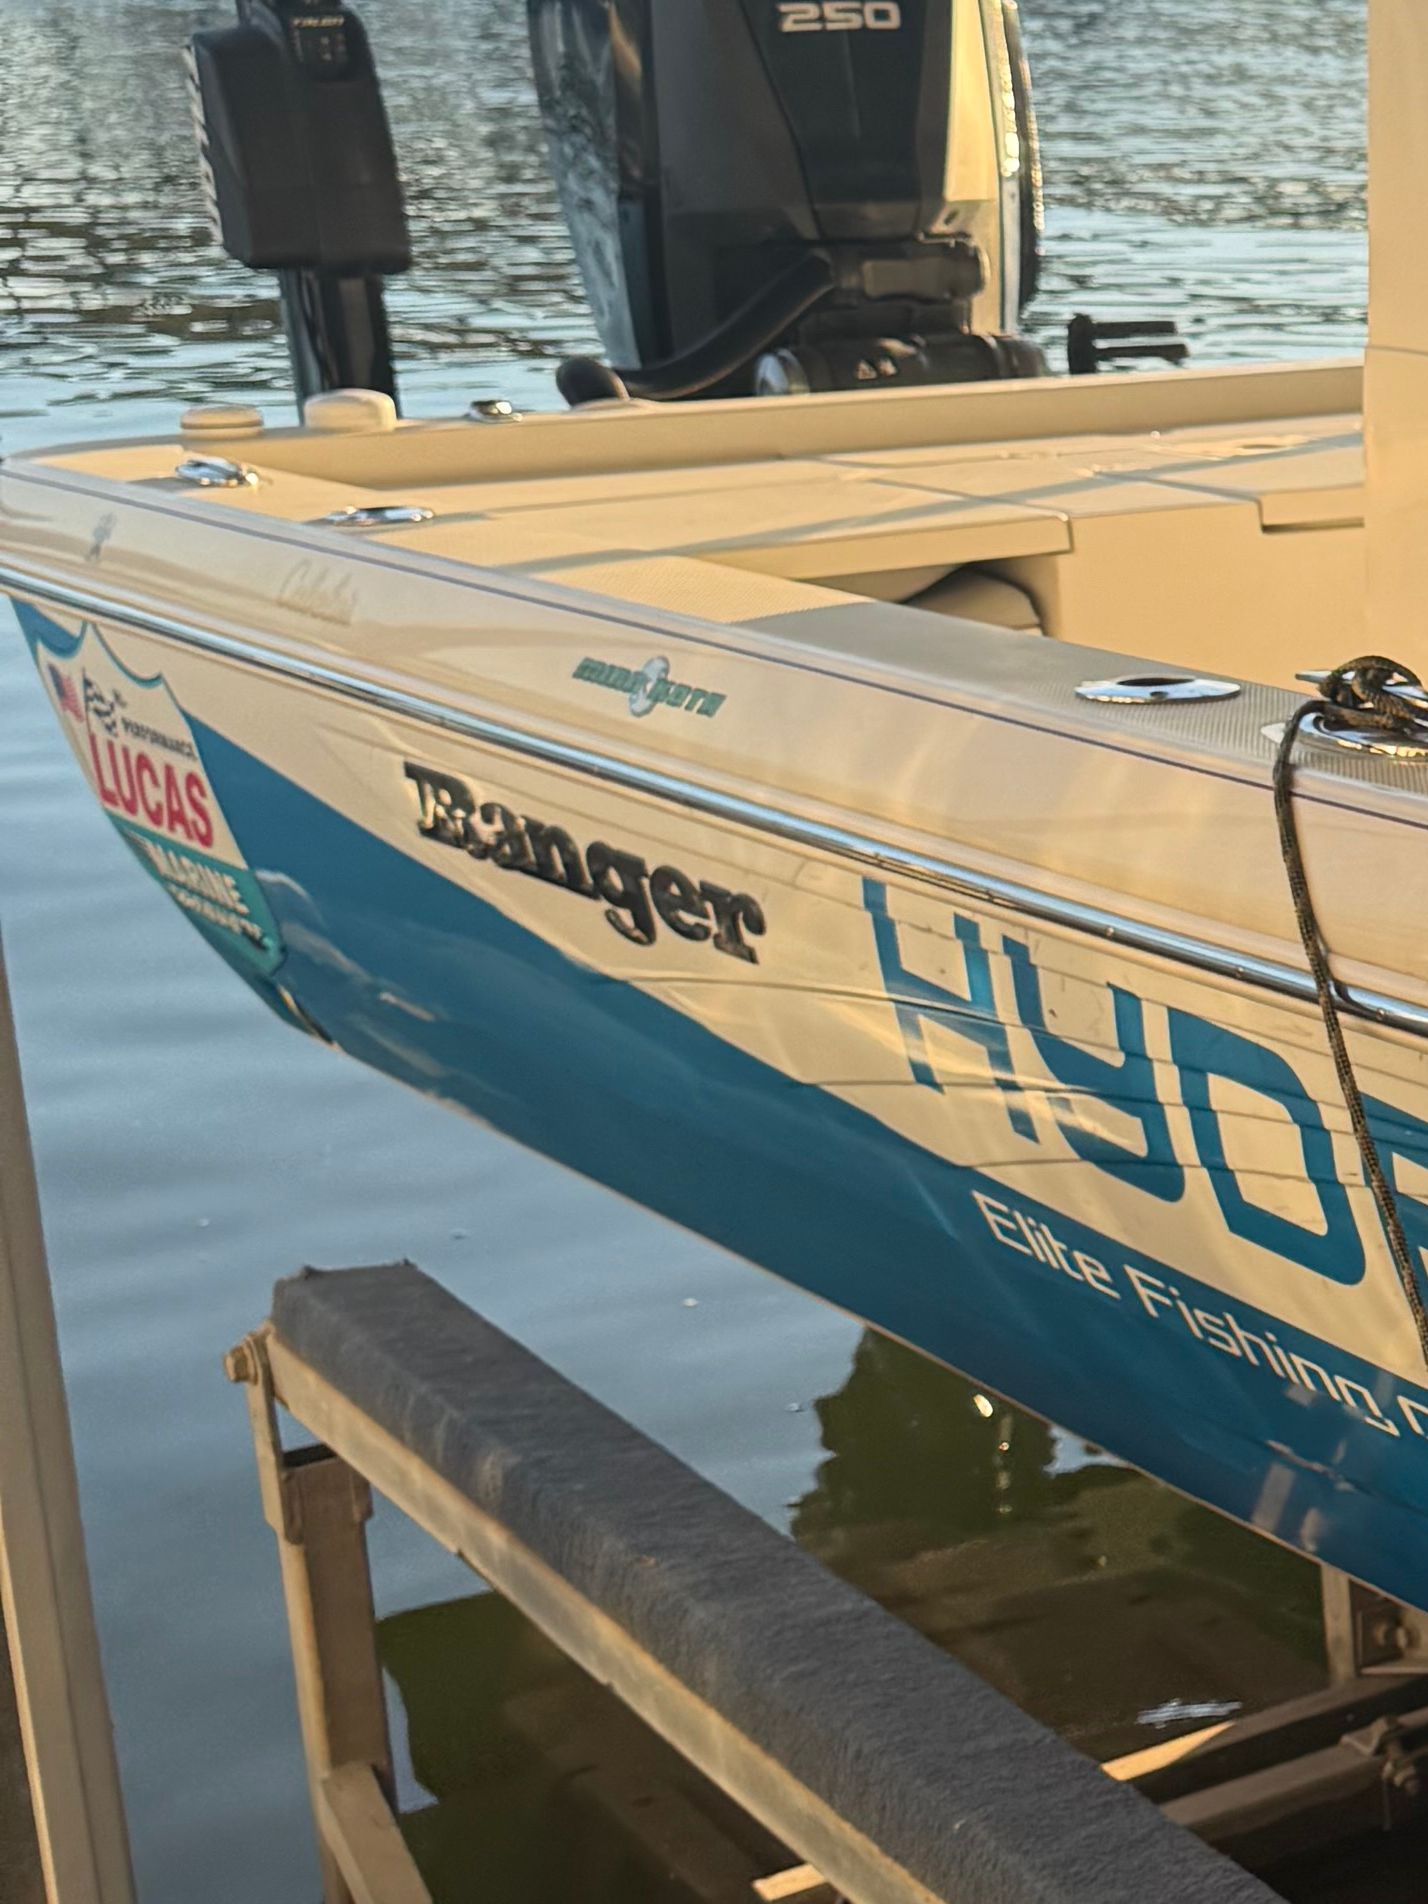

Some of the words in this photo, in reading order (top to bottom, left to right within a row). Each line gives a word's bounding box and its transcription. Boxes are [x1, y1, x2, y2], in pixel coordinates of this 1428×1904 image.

[778, 1, 901, 33] 250
[90, 734, 213, 849] LUCAS
[402, 761, 767, 964] Ranger
[972, 1190, 1120, 1298] Elite
[1124, 1263, 1400, 1437] Fishing
